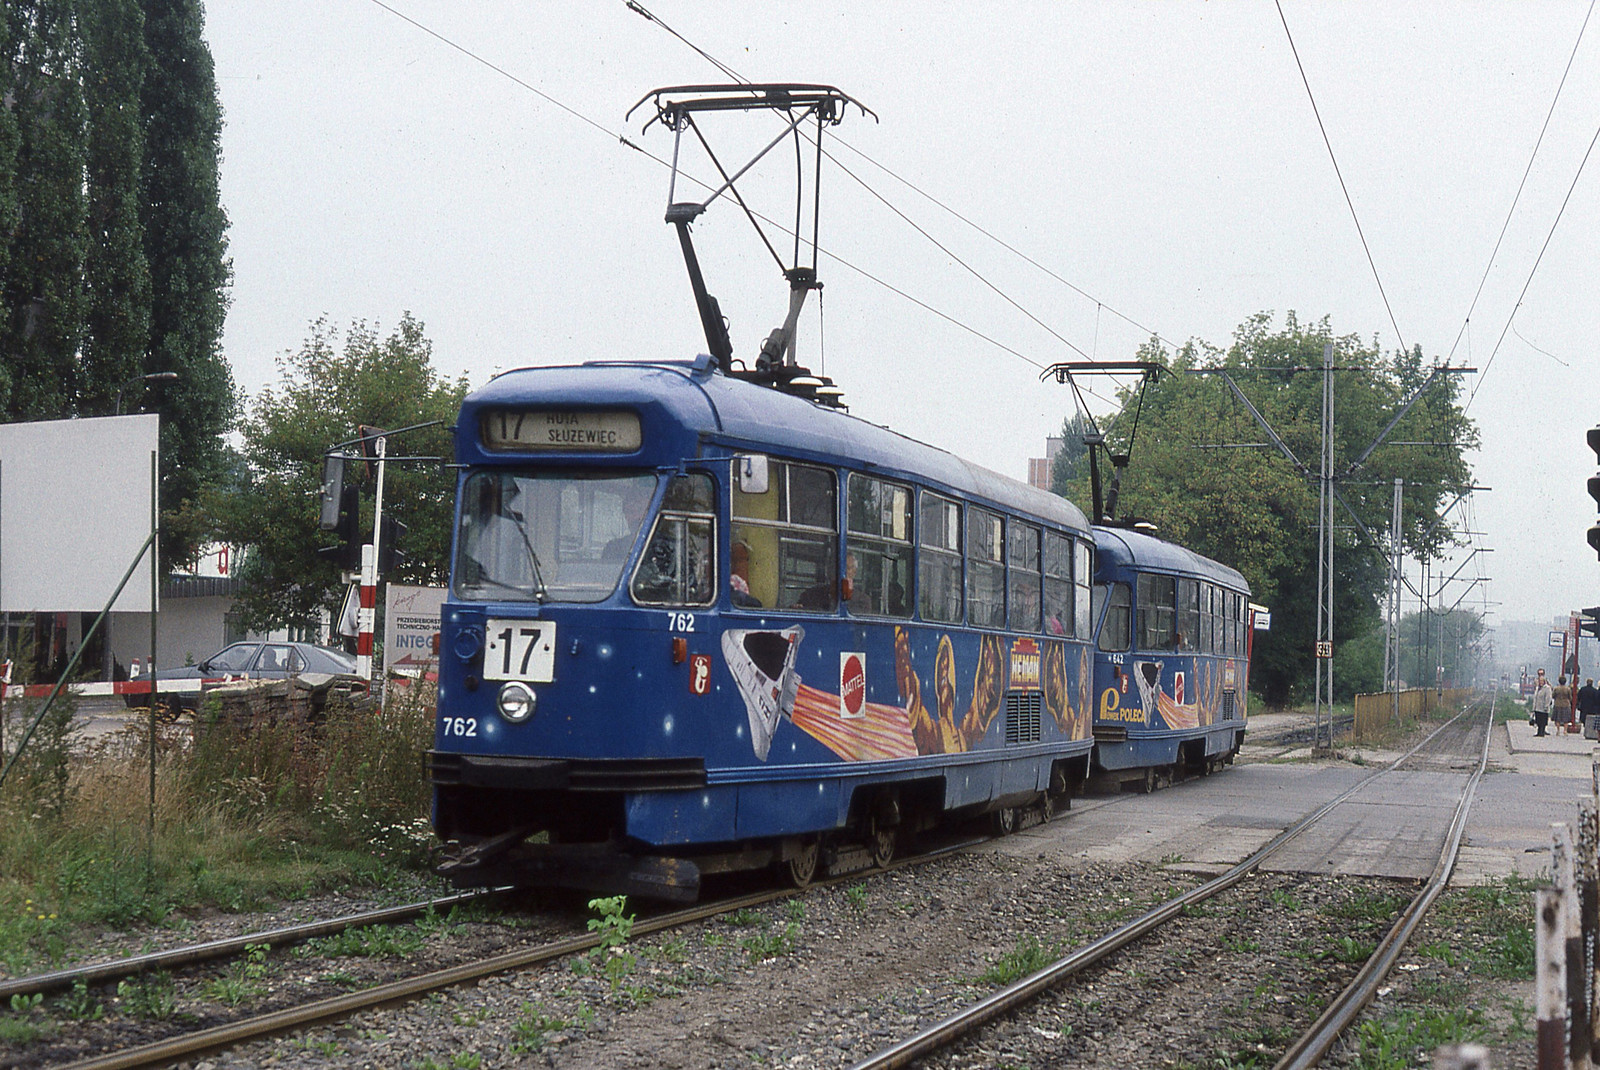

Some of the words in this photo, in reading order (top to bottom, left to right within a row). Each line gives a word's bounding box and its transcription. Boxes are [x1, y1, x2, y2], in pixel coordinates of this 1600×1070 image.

[497, 411, 526, 440] 17
[668, 612, 695, 632] 762
[498, 628, 541, 675] 17
[1120, 707, 1146, 723] POLECA
[443, 717, 477, 737] 762
